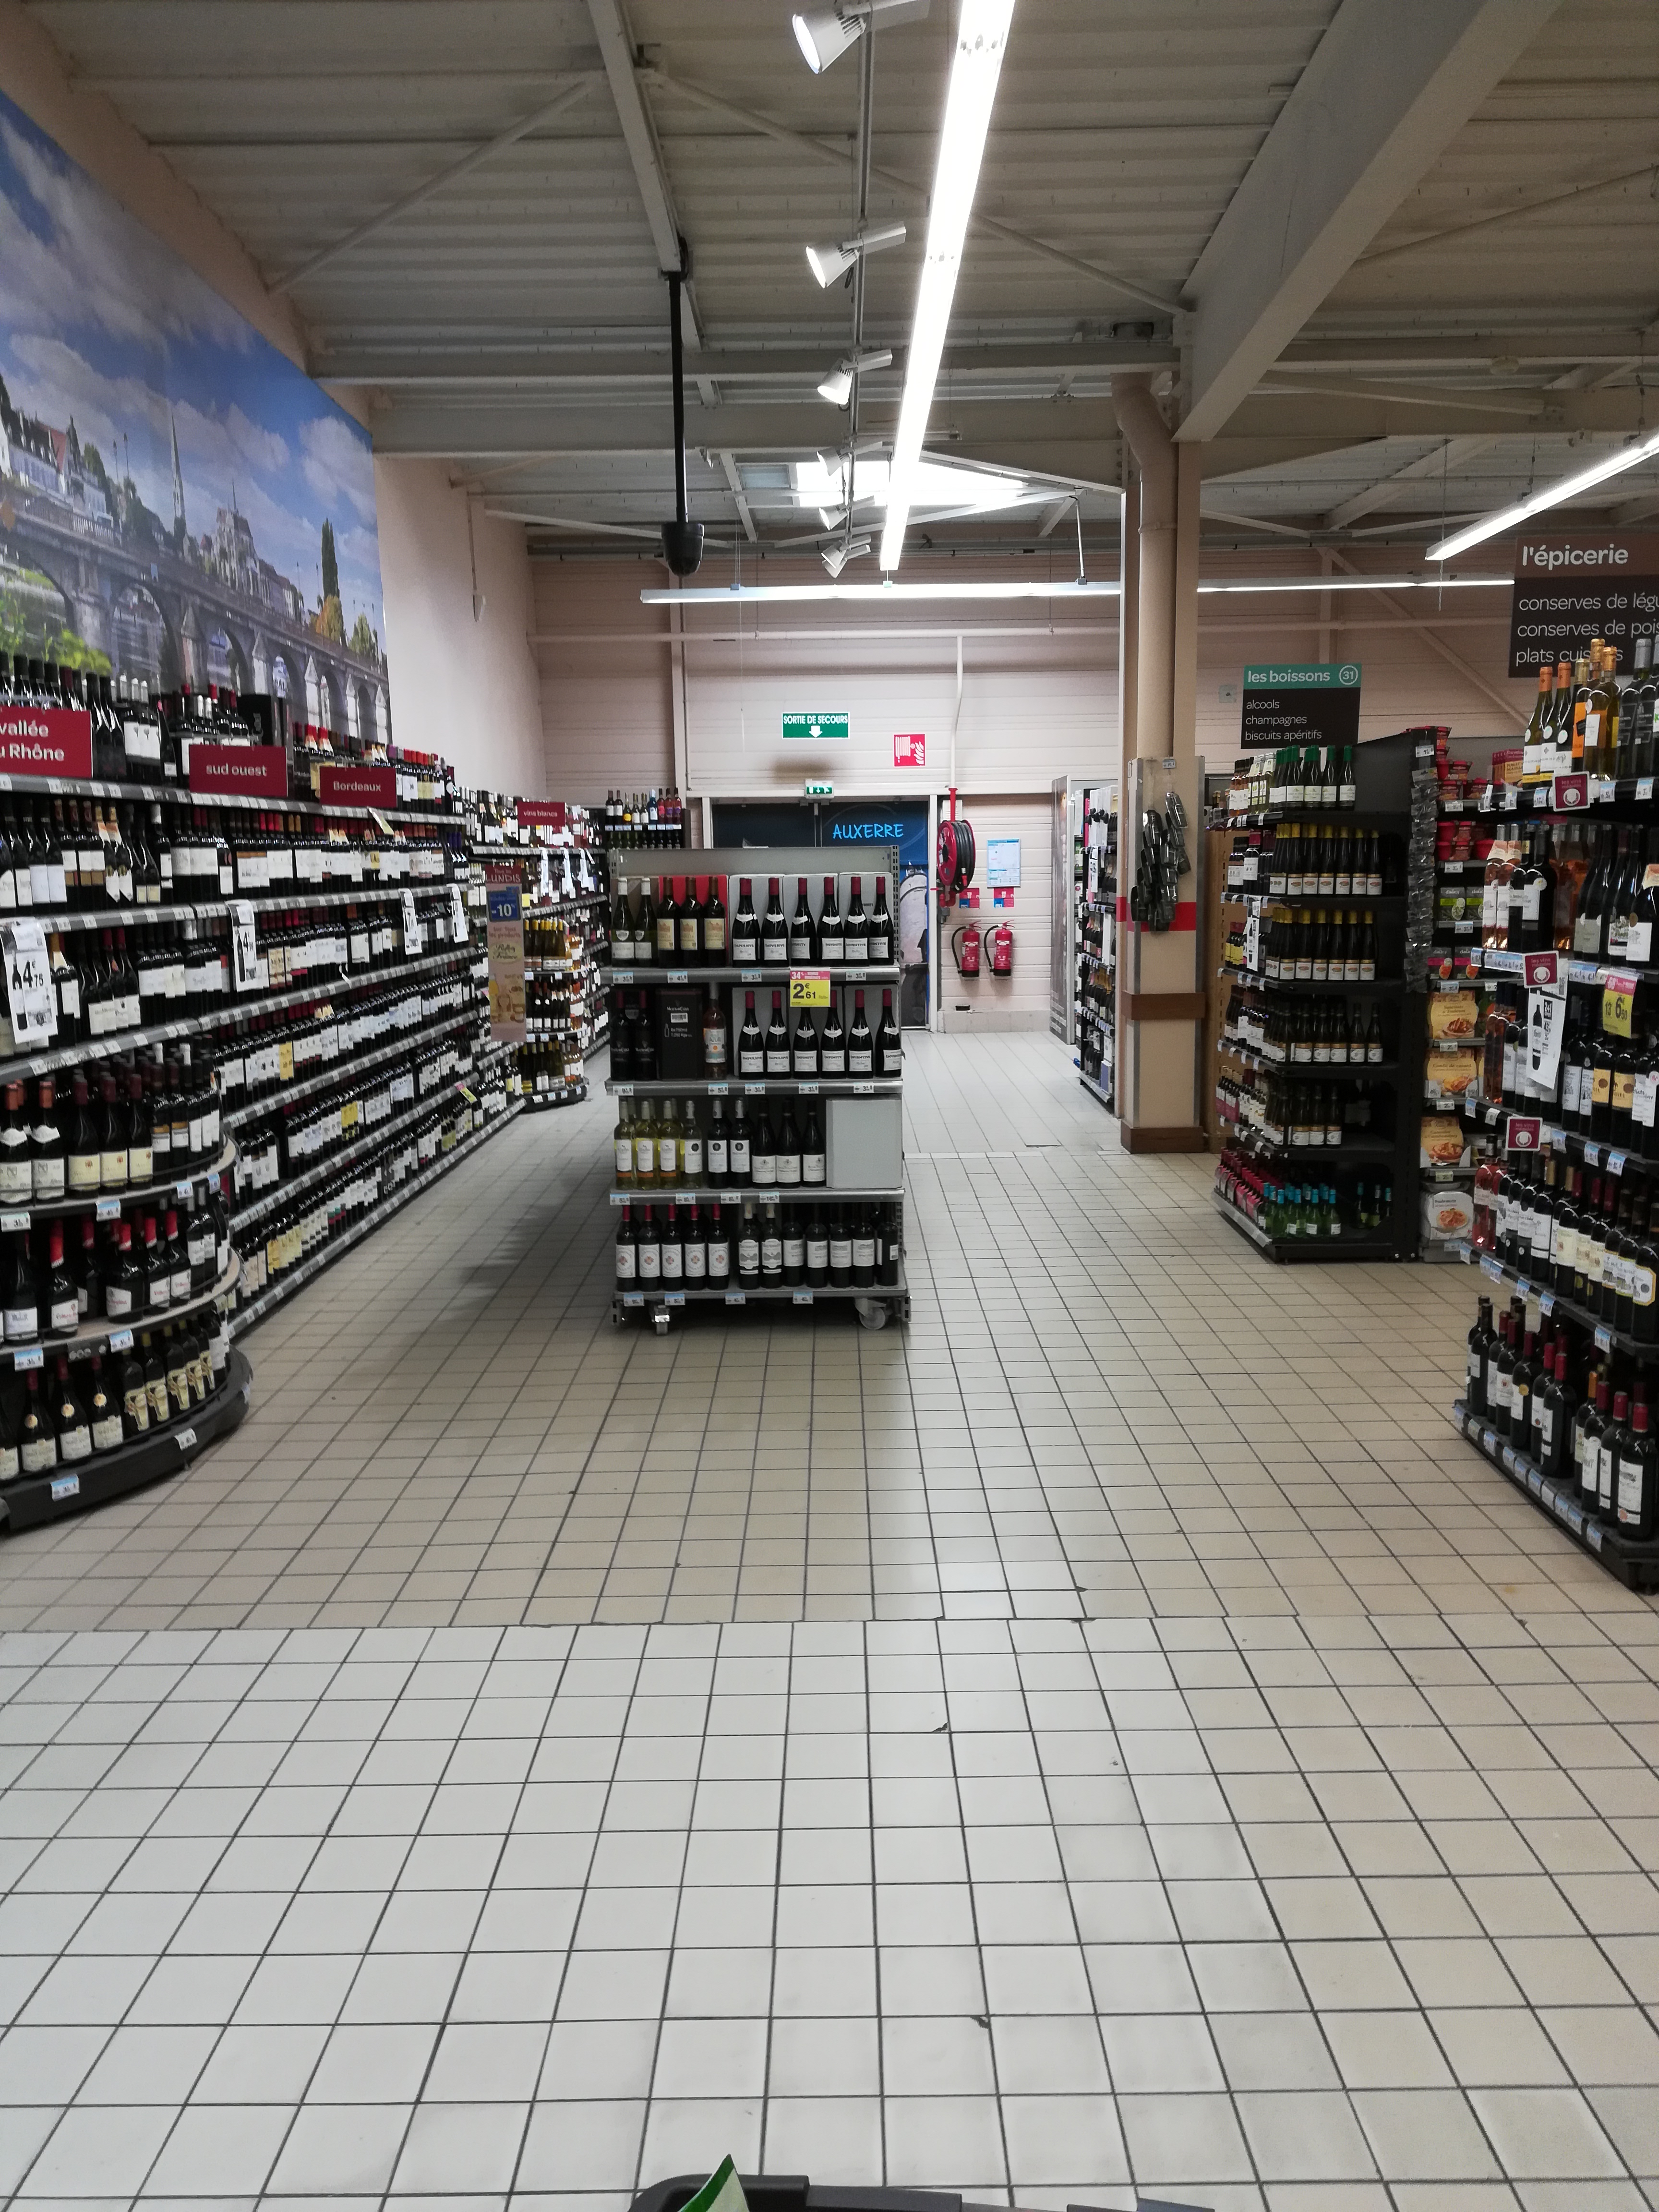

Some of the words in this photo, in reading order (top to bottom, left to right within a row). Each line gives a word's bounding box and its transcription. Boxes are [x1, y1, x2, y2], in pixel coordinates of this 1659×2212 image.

[1522, 543, 1629, 571] l'épicerie
[1519, 597, 1602, 611] conserves
[1607, 592, 1628, 609] de
[1517, 624, 1599, 637] conserves
[1605, 619, 1626, 635] de
[1516, 647, 1554, 667] plats
[1559, 646, 1623, 661] cuiss
[1248, 671, 1267, 683] les
[1270, 669, 1331, 683] boissons
[1343, 671, 1354, 680] 31
[1246, 699, 1280, 709] alcools
[783, 715, 805, 724] SORTIE
[807, 715, 817, 724] DE
[817, 715, 848, 724] SECOURS
[1246, 715, 1307, 727] champagnes
[0, 720, 49, 738] vallée
[1245, 731, 1281, 741] biscuits
[1284, 729, 1322, 742] apéritifs
[9, 742, 65, 762] Rhône
[206, 762, 229, 775] sud
[231, 764, 267, 777] ouest
[333, 781, 382, 792] Bordeaux
[832, 824, 904, 839] AUXERRE
[485, 874, 521, 883] LUNDIS
